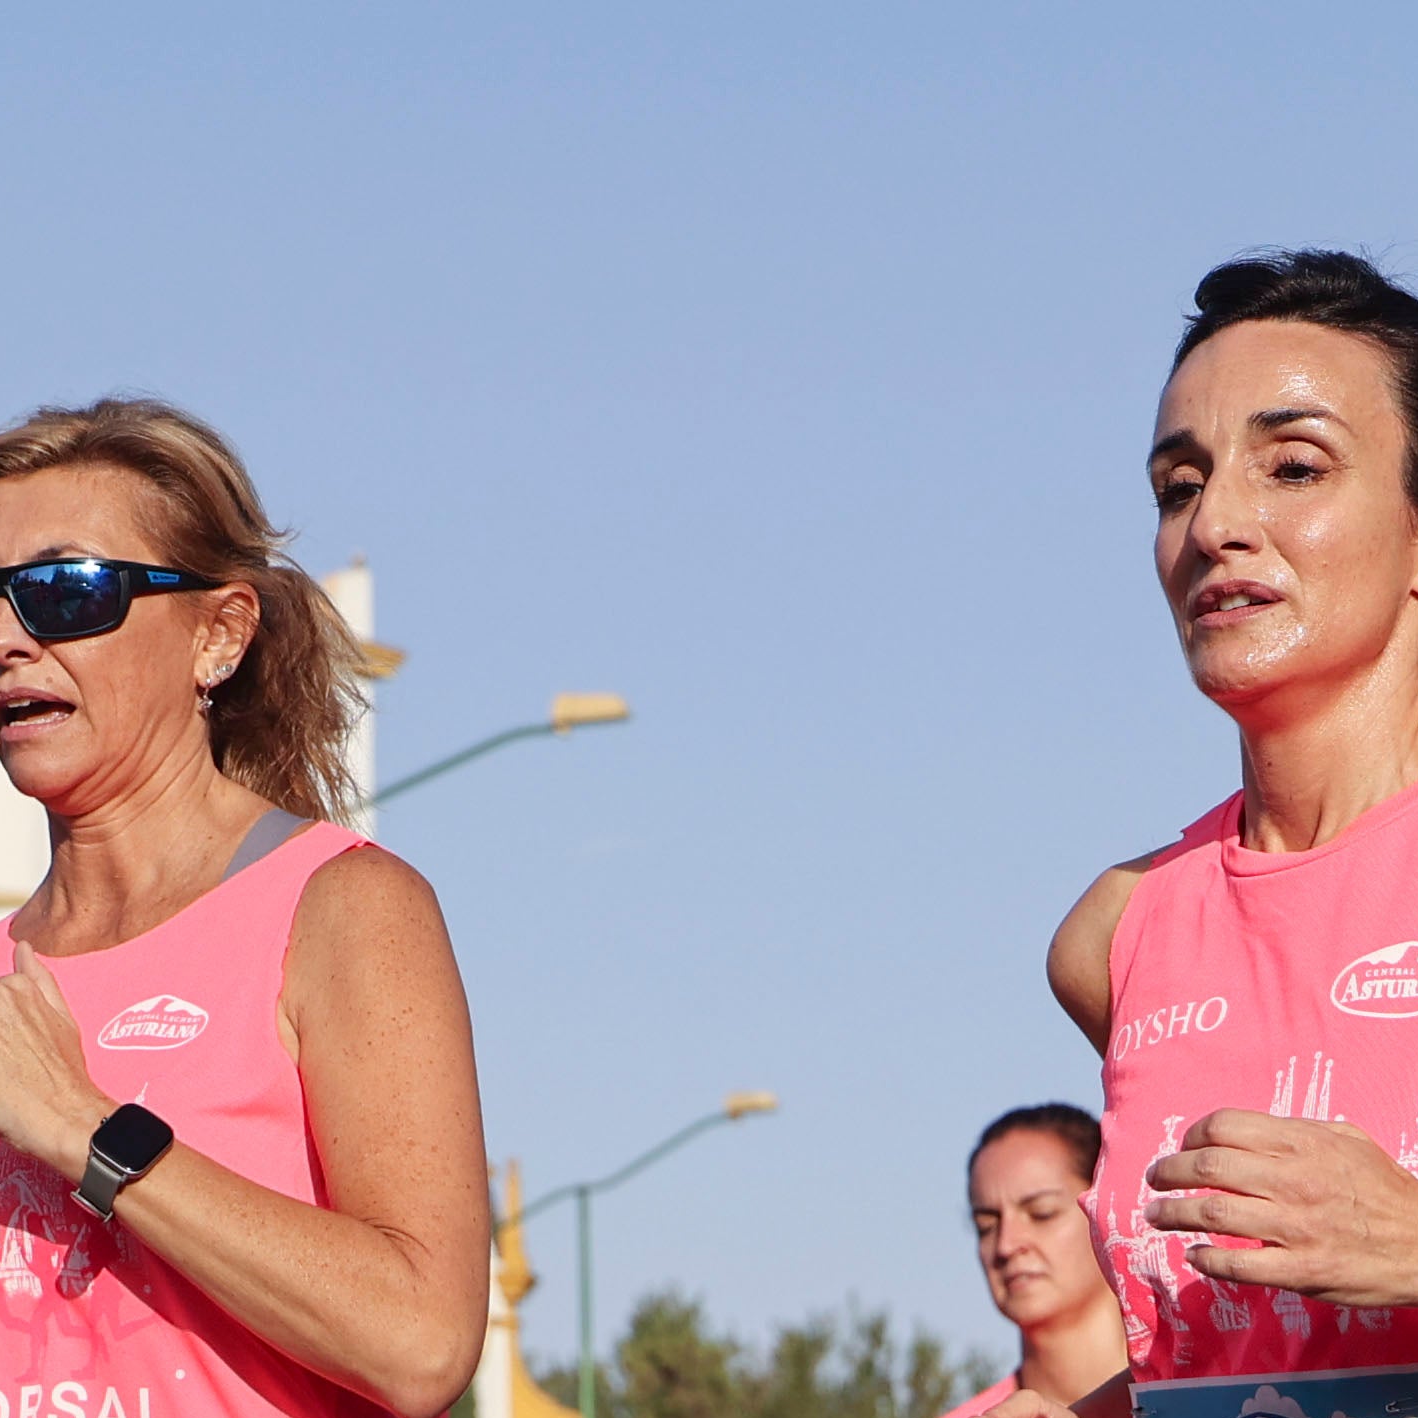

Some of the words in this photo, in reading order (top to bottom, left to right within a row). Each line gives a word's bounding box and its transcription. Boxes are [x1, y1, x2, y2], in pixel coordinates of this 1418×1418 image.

[1365, 967, 1416, 978] CENTRAL
[103, 1020, 199, 1041] ASTURIANA
[1113, 996, 1228, 1062] OYSHO
